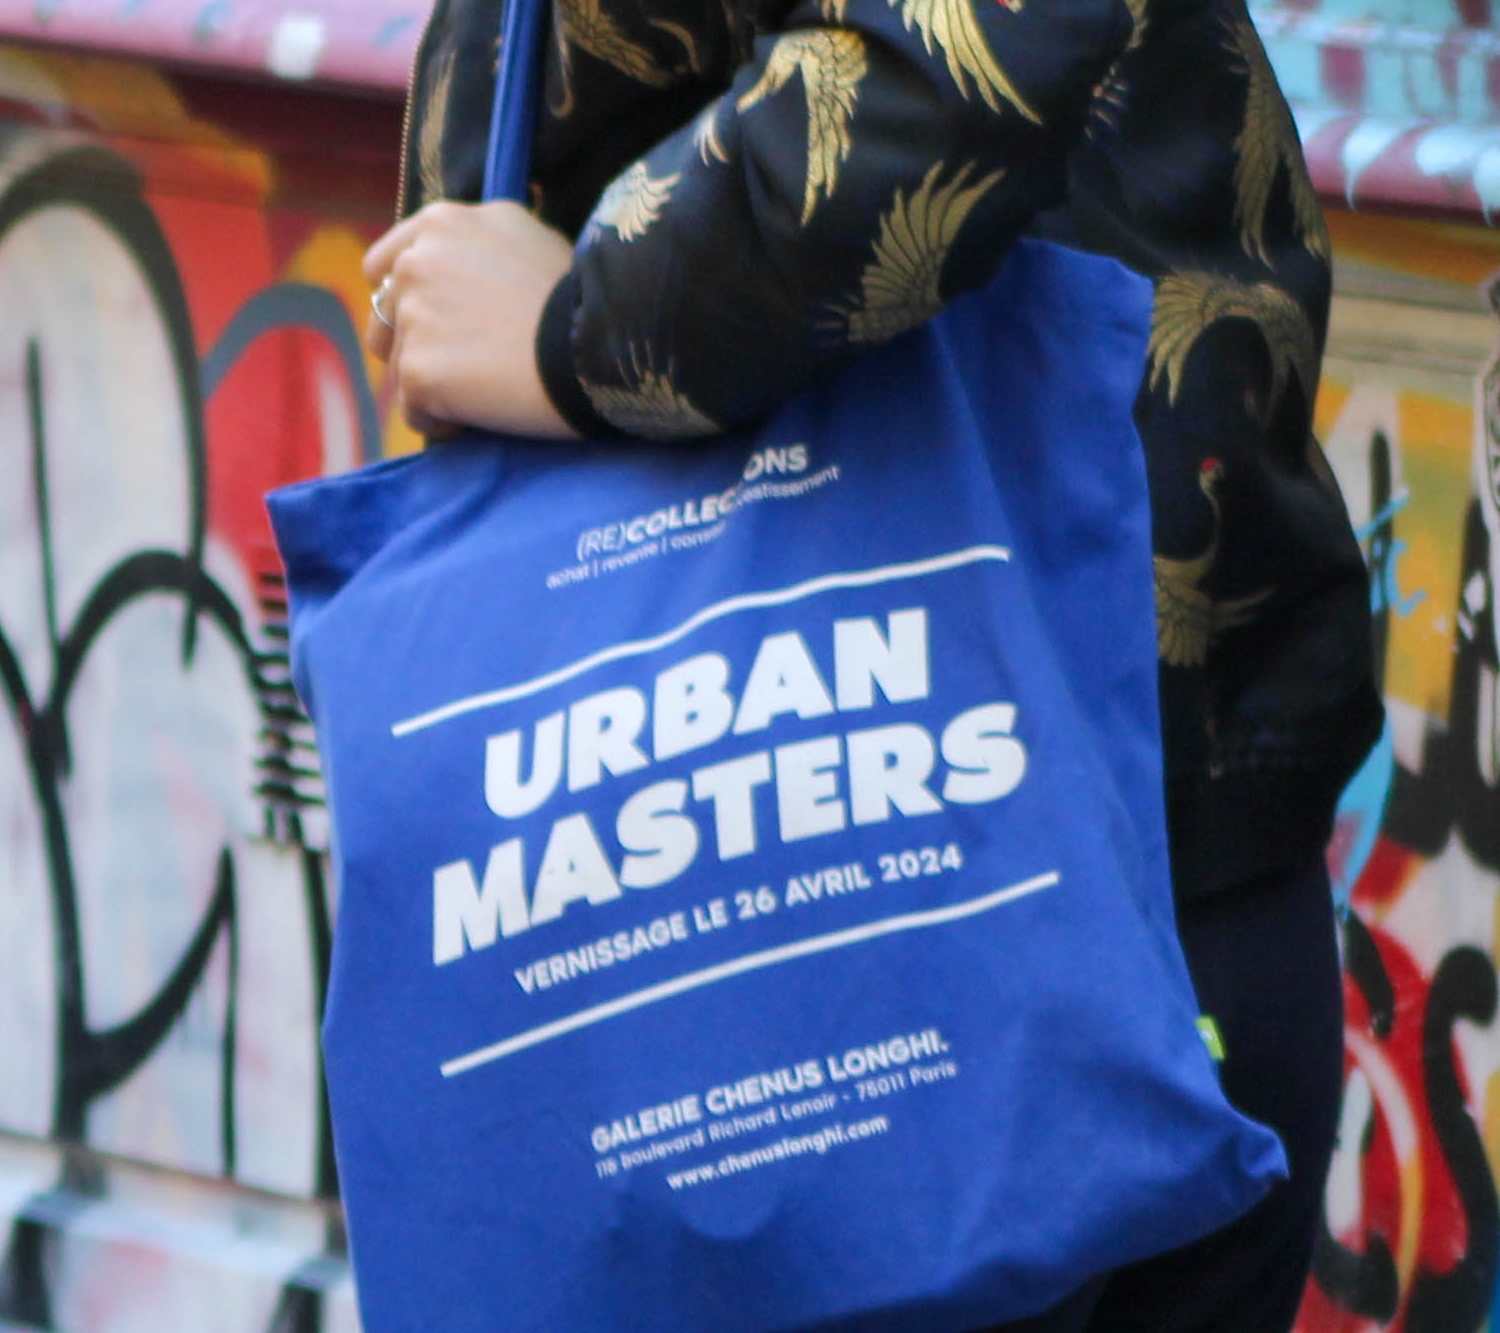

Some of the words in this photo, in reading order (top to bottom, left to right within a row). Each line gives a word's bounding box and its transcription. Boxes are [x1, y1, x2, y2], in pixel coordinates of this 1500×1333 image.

[577, 444, 809, 561] (RE)COLLECONS
[483, 608, 930, 820] URBAN
[432, 702, 1027, 967] MASTERS
[514, 910, 688, 995] VERNISSAGE
[693, 899, 729, 932] LE
[735, 887, 777, 920] 26
[784, 863, 871, 908] AVRIL
[878, 844, 963, 884] 2024
[591, 1094, 702, 1152] GALERIE
[705, 1060, 824, 1114] CHENUS
[619, 1128, 704, 1170] boulevard
[707, 1107, 778, 1143] Richard
[779, 1092, 838, 1121] Lenoir
[855, 1072, 907, 1102] 75011
[908, 1060, 959, 1087] Paris
[664, 1116, 890, 1190] www.chenuslonghi.com
